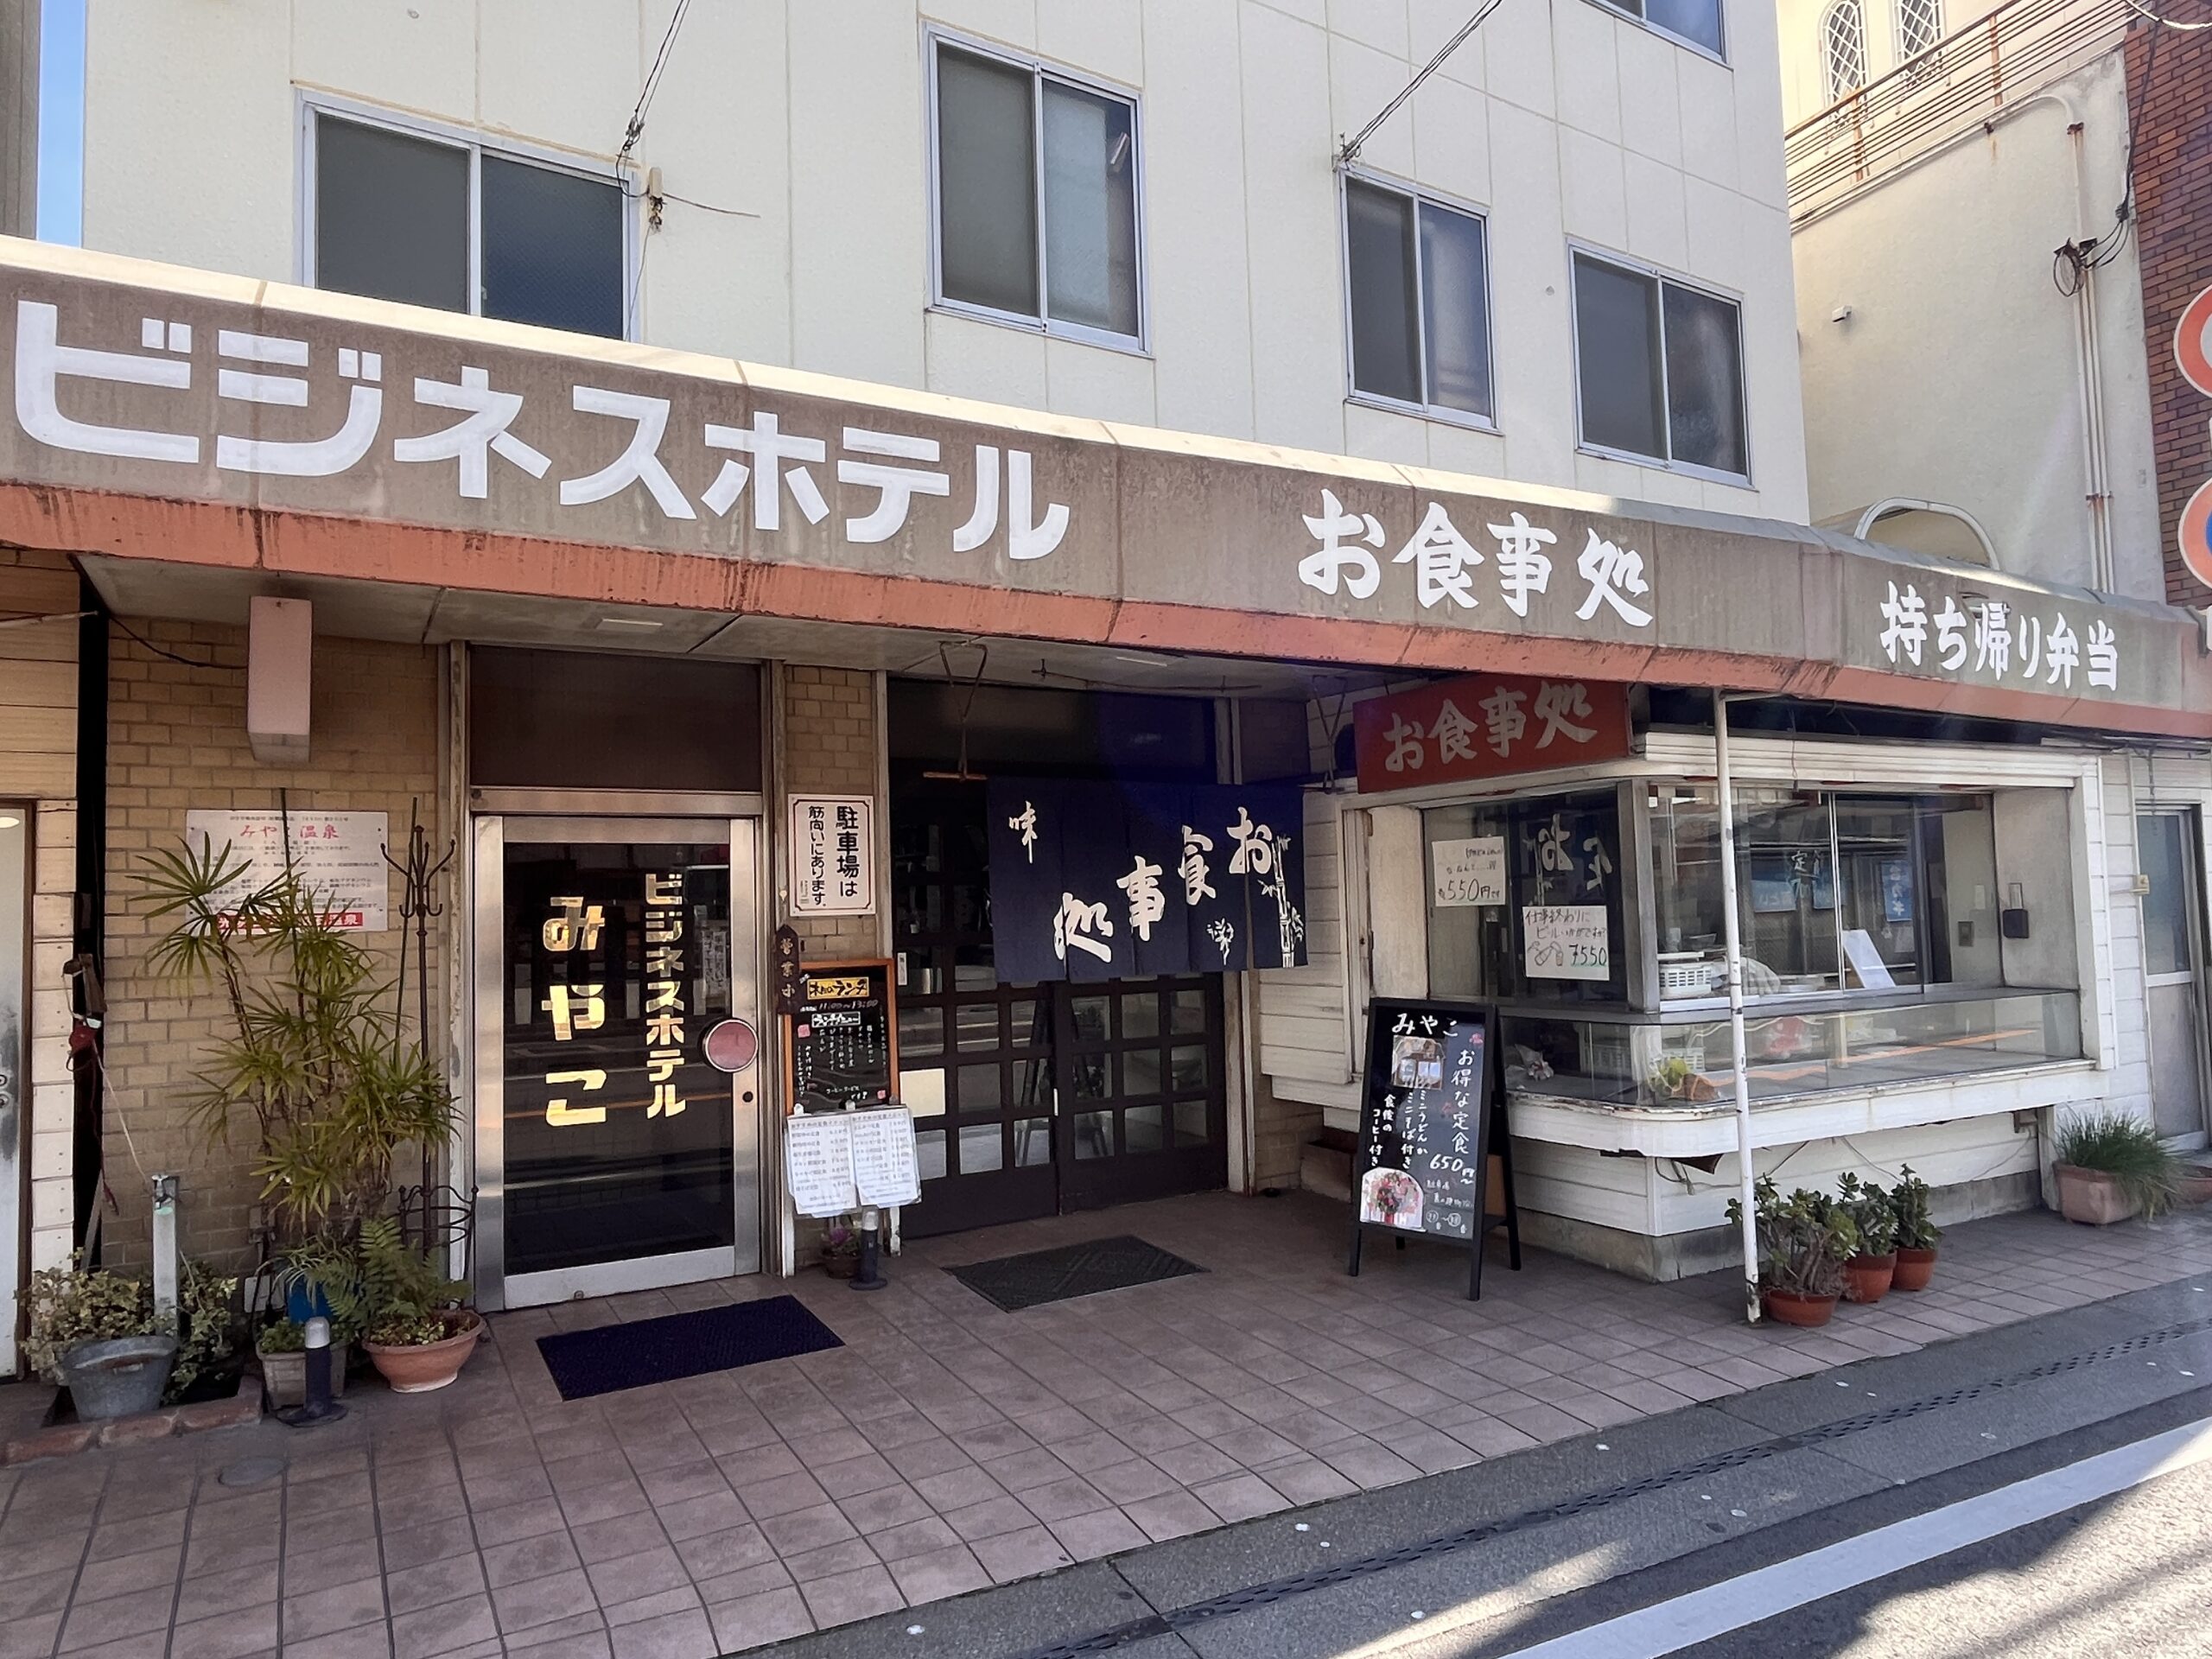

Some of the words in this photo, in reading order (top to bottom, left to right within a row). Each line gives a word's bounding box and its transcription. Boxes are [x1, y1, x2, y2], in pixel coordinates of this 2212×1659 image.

[16, 299, 1071, 561] ビジネスホテル
[1298, 488, 1654, 628] お食事処
[1880, 581, 2120, 692] 持ち帰り弁当
[1383, 681, 1599, 772] お食事処
[240, 823, 340, 840] みや温泉
[836, 806, 860, 898] 駐車場は
[1009, 801, 1037, 864] 味
[542, 896, 607, 1127] みやこ
[645, 874, 685, 1119] ビジネスホテル
[1392, 1013, 1458, 1037] みやこ
[1369, 1109, 1383, 1166] コーヒー付き
[1451, 1049, 1475, 1154] お得な定食
